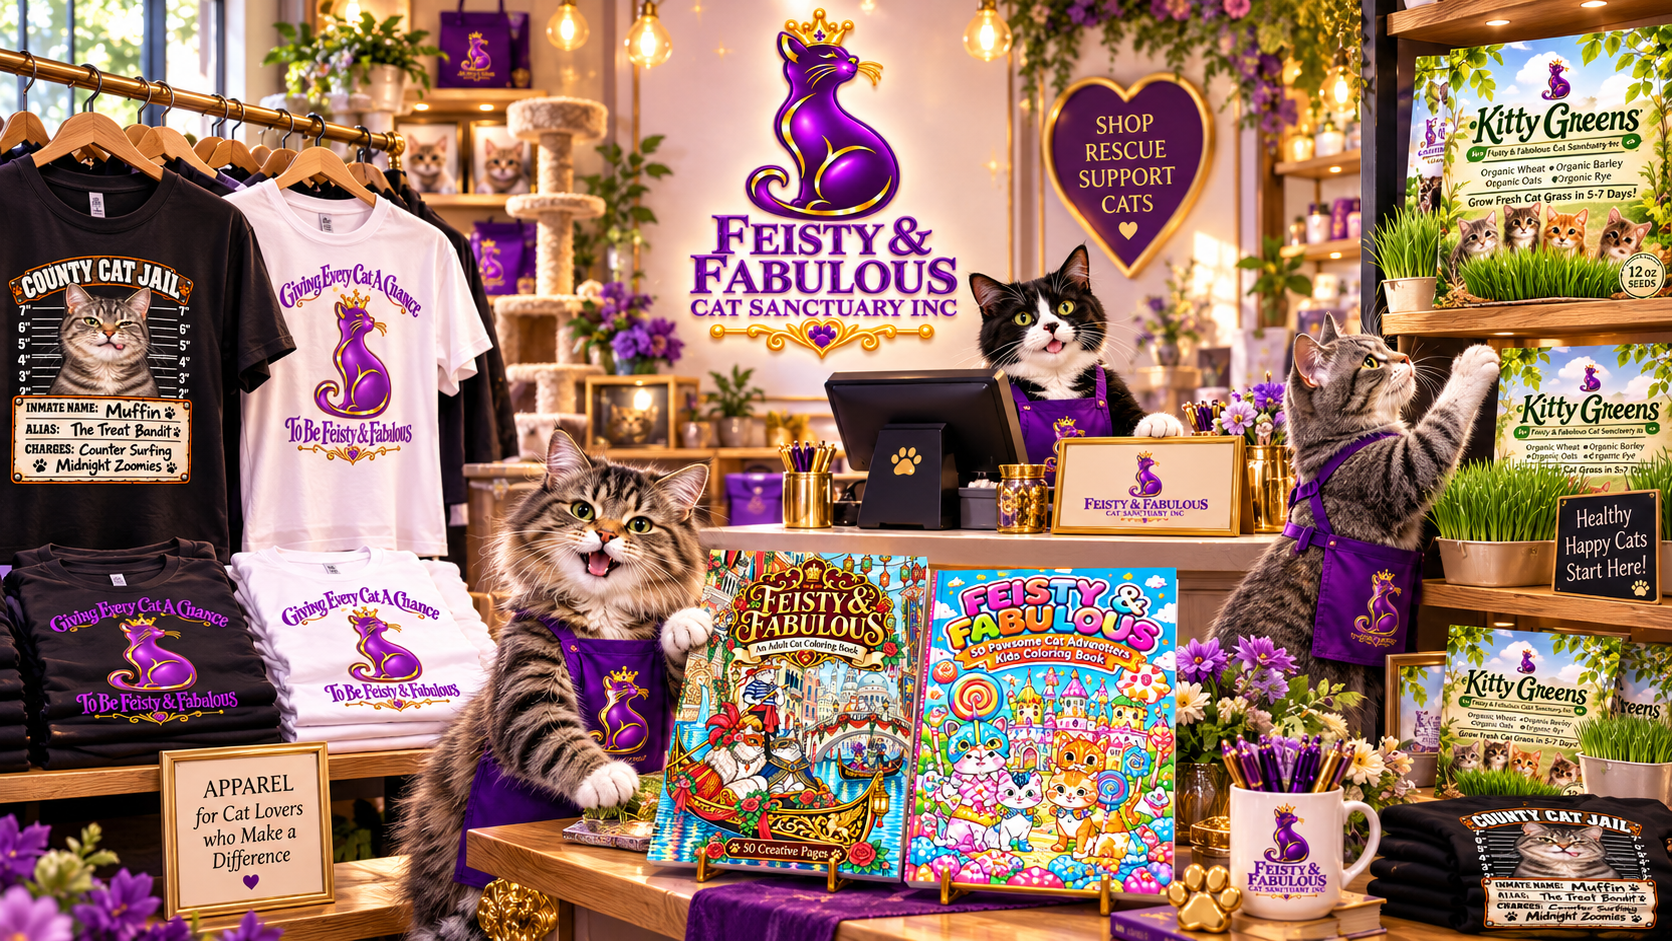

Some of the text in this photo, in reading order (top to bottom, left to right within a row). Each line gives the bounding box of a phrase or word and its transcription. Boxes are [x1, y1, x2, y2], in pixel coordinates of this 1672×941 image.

[1096, 113, 1154, 135] SHOP
[1472, 102, 1640, 145] Kitty Greens
[1085, 140, 1167, 162] RESCUE
[1078, 166, 1176, 188] SUPPORT
[1517, 165, 1546, 174] Wheat
[1556, 161, 1591, 172] Organic
[1593, 159, 1625, 169] Barley
[1594, 172, 1612, 183] Rye
[1101, 194, 1154, 214] CATS
[1468, 198, 1494, 207] Grow
[1496, 194, 1522, 206] Fresh
[1524, 193, 1542, 203] Cat
[1544, 191, 1573, 203] Grass
[1575, 190, 1585, 200] in
[1607, 188, 1637, 201] Days!
[711, 214, 932, 256] FEISTY &
[21, 258, 180, 299] COUNTY CAT JAIL
[690, 255, 958, 295] FABULOUS
[1629, 266, 1643, 278] 12
[279, 263, 383, 308] Giving Every Cat A
[1628, 279, 1656, 288] SEEDS
[690, 299, 958, 316] CAT SANCTUARY INC
[26, 402, 161, 419] INMATE NAME: Muffin
[1520, 393, 1660, 426] Kitty Greens
[25, 422, 172, 438] ALIAS: The Treat Bandit
[285, 416, 302, 442] To
[303, 419, 320, 443] Be
[321, 421, 357, 446] Feisty
[357, 423, 369, 443] &
[25, 443, 172, 461] CHARGES: Counter Surfing
[56, 458, 162, 475] Midnight Zoomies
[1604, 465, 1612, 473] in
[1084, 498, 1208, 510] FEISTY & FABULOUS
[1576, 504, 1632, 528] Healthy
[1565, 531, 1648, 559] Happy Cats
[1566, 554, 1646, 582] Start Here!
[282, 601, 327, 626] Giving
[323, 591, 358, 610] Every
[359, 587, 380, 604] Cat
[382, 589, 394, 605] A
[750, 584, 875, 614] FEISTY &
[962, 577, 1148, 617] FEISTY &
[50, 610, 100, 633] Giving
[96, 601, 136, 617] Every
[137, 597, 162, 613] Cat
[164, 599, 176, 615] A
[735, 610, 885, 646] FABULOUS
[946, 605, 1160, 652] FABULOUS
[804, 640, 837, 652] Coloring
[988, 636, 1065, 654] Pawsome Cat
[1024, 648, 1072, 660] Coloring
[1075, 650, 1105, 665] Book
[324, 683, 345, 702] To
[345, 684, 363, 701] Be
[364, 683, 397, 700] Feisty
[398, 684, 409, 697] &
[1464, 670, 1588, 705] Kitty Greens
[76, 691, 238, 714] To Be Feisty & Fabulous
[203, 775, 294, 798] APPAREL
[193, 803, 303, 830] for Cat Lovers
[1471, 809, 1632, 833] COUNTY CAT JAIL
[203, 824, 297, 847] who Make a
[213, 849, 291, 872] Difference
[743, 842, 756, 854] 50
[757, 843, 798, 857] Creative
[1254, 861, 1320, 876] FEISTY &
[1247, 873, 1327, 887] FABULOUS
[1572, 882, 1625, 892] Muffin
[1539, 892, 1563, 900] The
[1526, 911, 1578, 923] Midnight
